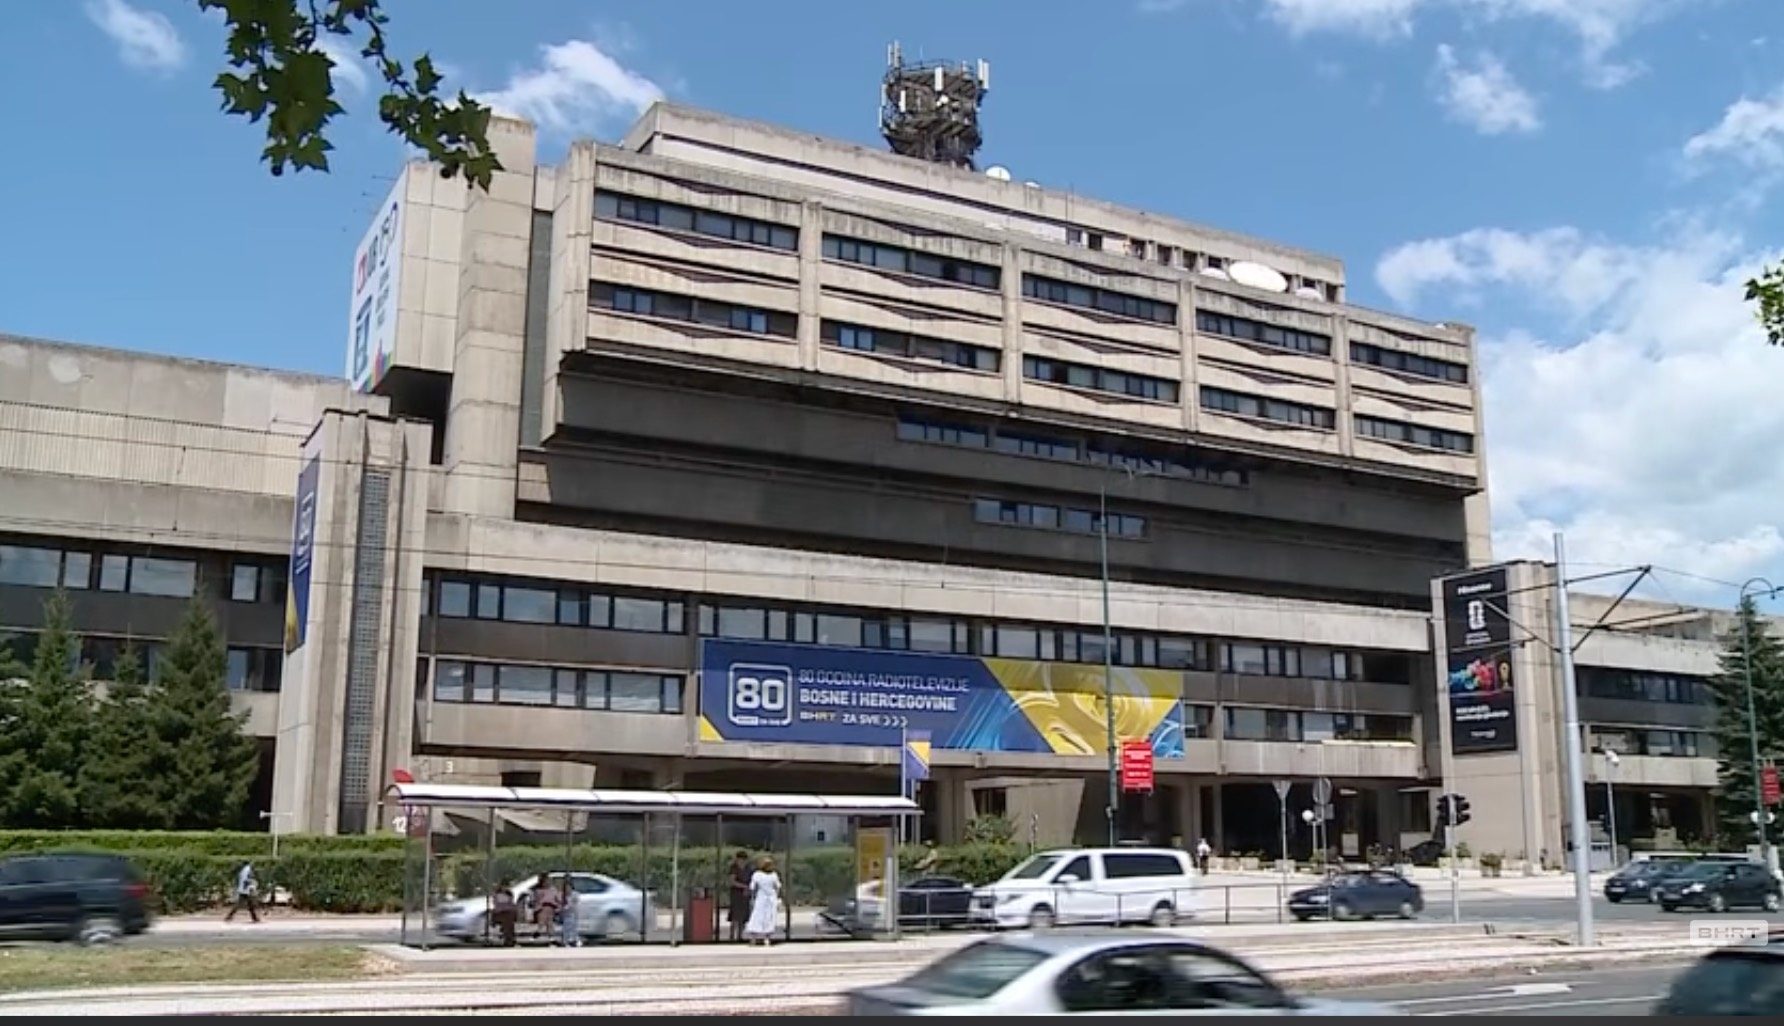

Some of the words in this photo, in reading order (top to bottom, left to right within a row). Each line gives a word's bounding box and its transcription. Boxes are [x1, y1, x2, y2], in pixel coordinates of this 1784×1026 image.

[800, 669, 814, 684] 80
[816, 669, 866, 687] GODINA
[736, 677, 784, 710] 80
[800, 688, 849, 705] BOSNE
[851, 692, 858, 706] I
[860, 692, 957, 711] HERCEGOVINE
[842, 713, 858, 725] ZA
[860, 713, 881, 725] SVE
